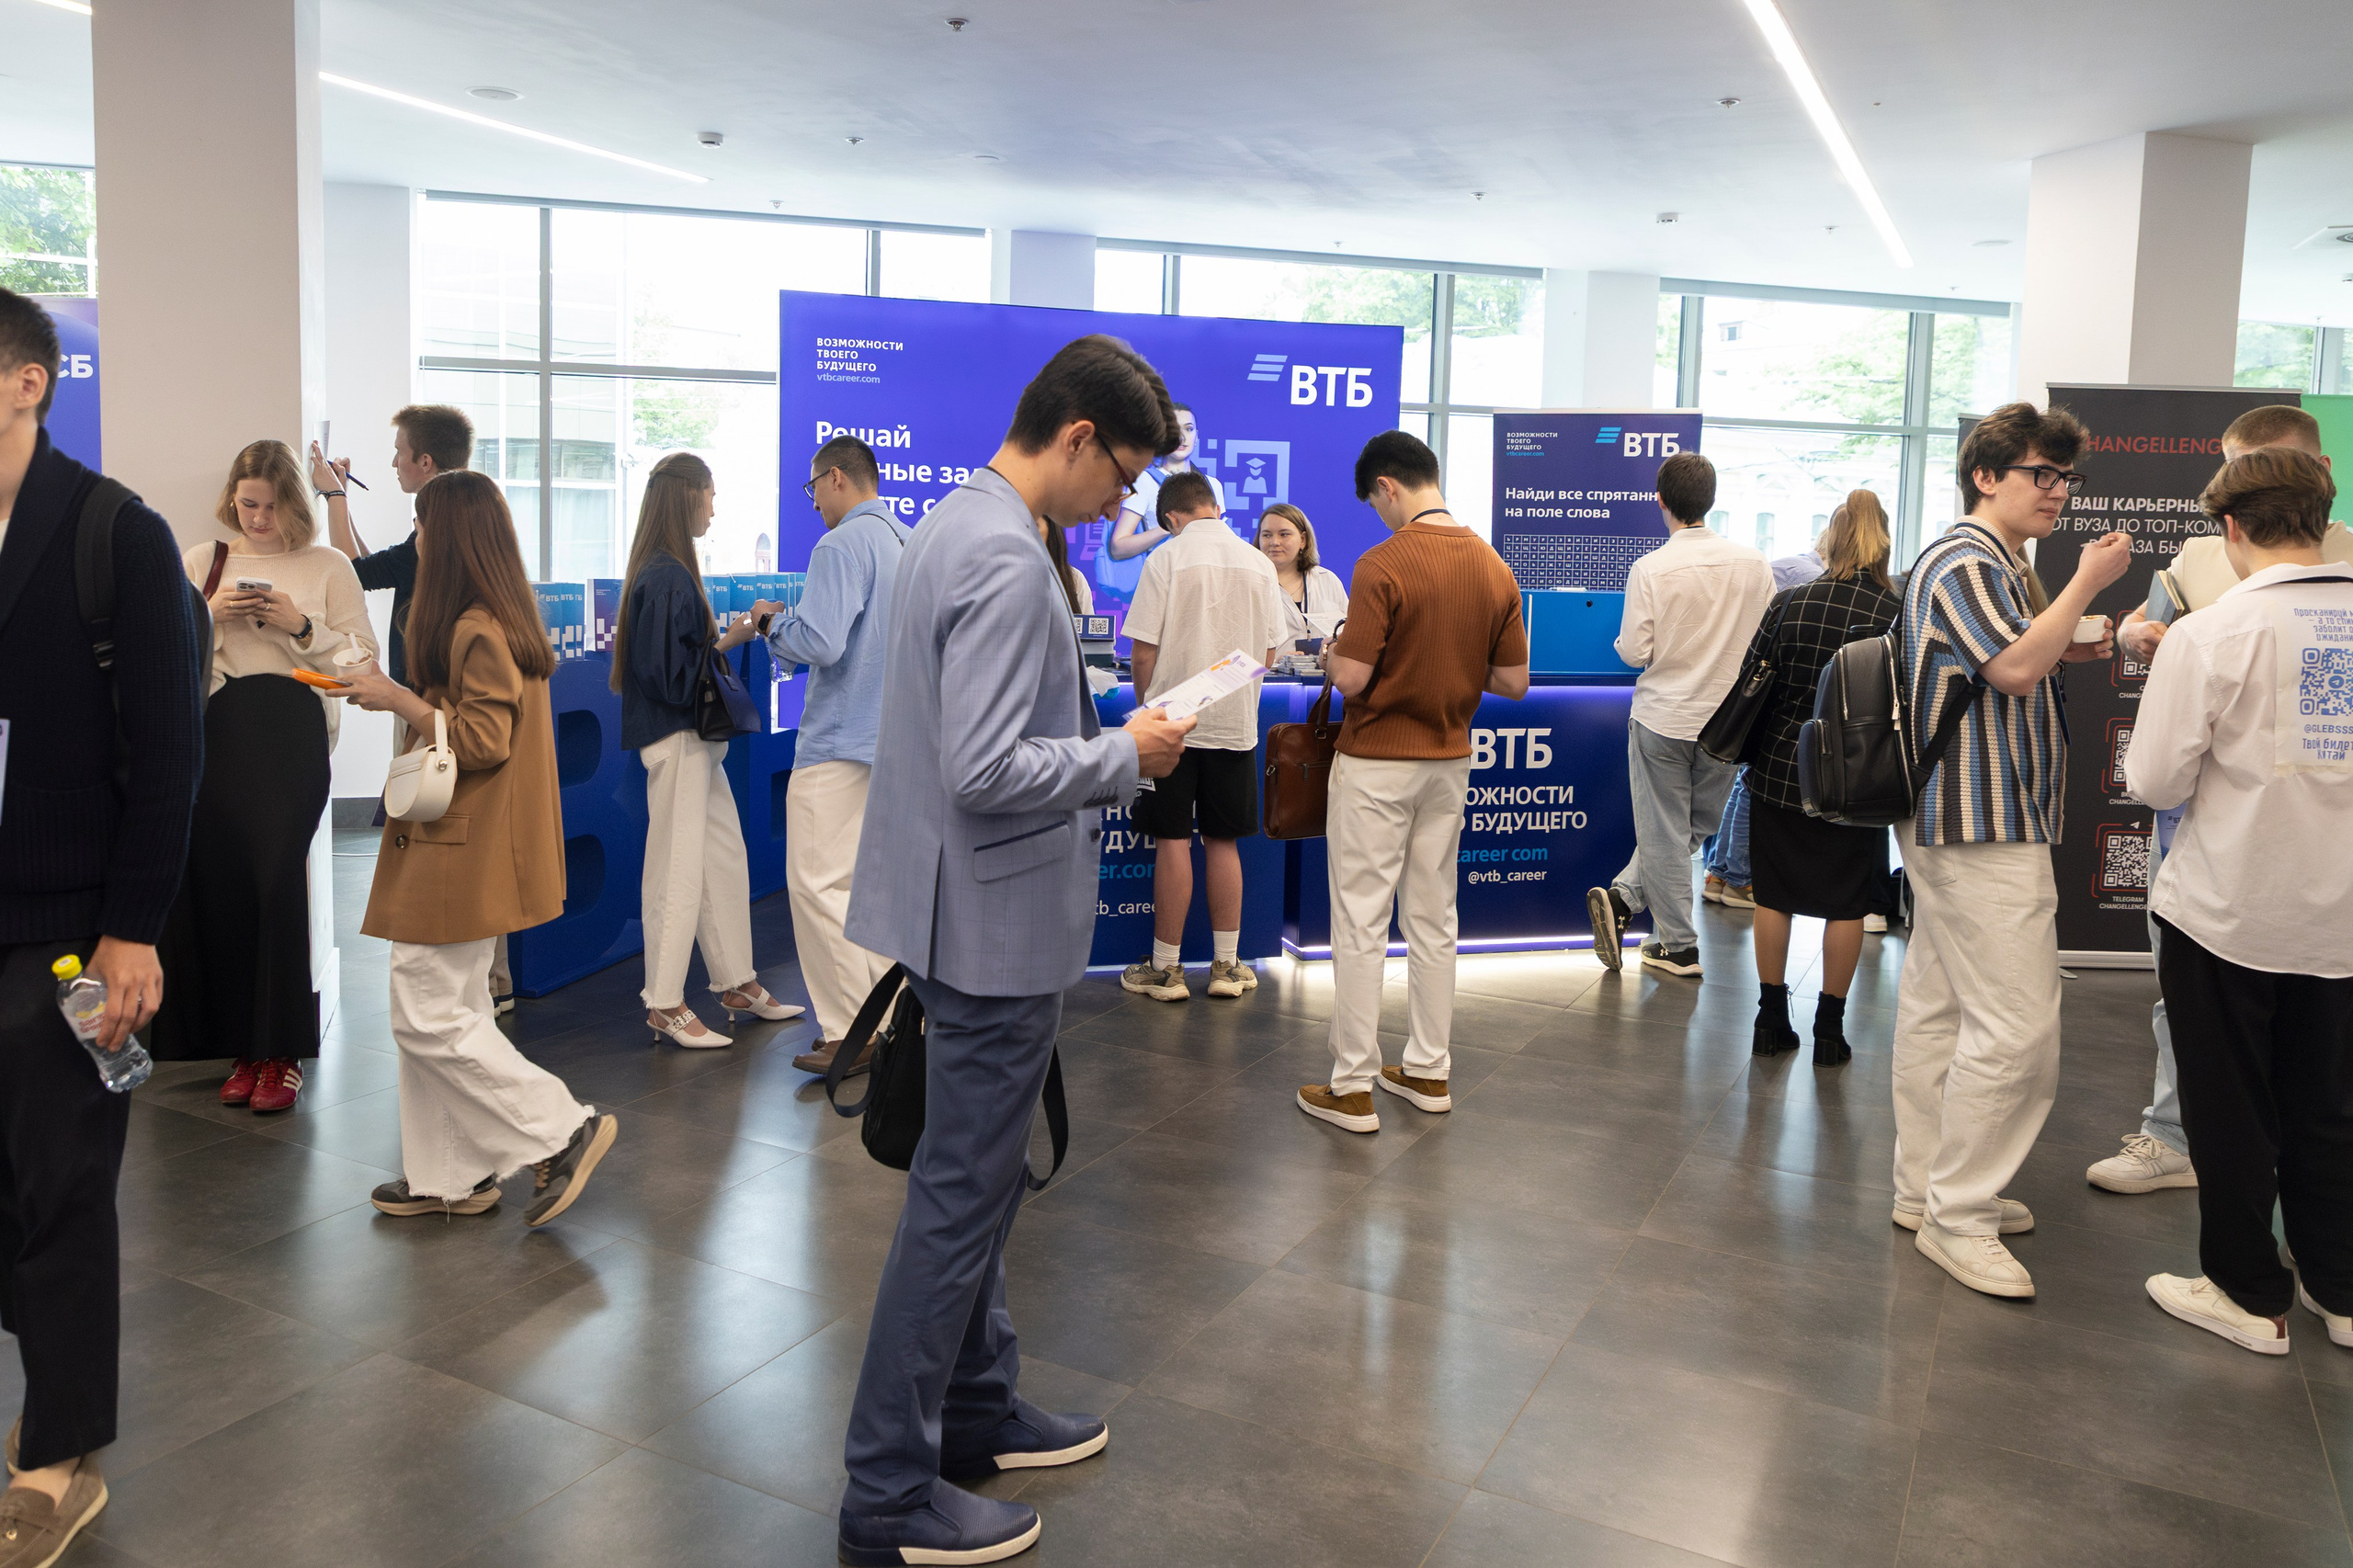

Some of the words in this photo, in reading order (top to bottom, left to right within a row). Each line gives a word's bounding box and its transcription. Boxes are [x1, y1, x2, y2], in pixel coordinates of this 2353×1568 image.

[816, 337, 904, 351] ВОЗМОЖНОСТИ
[816, 349, 858, 359] ТВОЕГО
[816, 360, 877, 372] БУДУЩЕГО
[817, 373, 881, 383] vtbcareer.com
[1290, 365, 1373, 407] ВТБ
[816, 421, 911, 449] Решай
[1623, 432, 1680, 457] ВТБ
[2086, 436, 2222, 455] HANGELLENG
[877, 463, 932, 483] ные
[939, 466, 976, 484] за
[1506, 487, 1554, 501] Найди
[1558, 491, 1583, 500] все
[1586, 491, 1658, 503] спрятанн
[879, 495, 915, 515] те
[2071, 496, 2109, 511] ВАШ
[2113, 497, 2204, 513] КАРЬЕРНЫ
[1505, 507, 1523, 517] на
[1527, 507, 1563, 517] поле
[1567, 508, 1610, 518] слова
[2052, 517, 2070, 531] ОТ
[2074, 517, 2110, 532] ВУЗА
[2115, 518, 2141, 533] ДО
[2144, 518, 2220, 534] ТОП-КОМ
[2159, 540, 2182, 554] БЫ
[2293, 608, 2347, 619] Просканируй
[2325, 617, 2335, 625] то
[2313, 624, 2347, 633] заболит
[2316, 633, 2353, 642] ожидани
[2304, 723, 2353, 734] @GLEBSSS
[1471, 728, 1552, 769] ВТБ
[2302, 737, 2321, 749] Твой
[1465, 786, 1574, 805] ОЖНОСТИ
[1472, 811, 1587, 835] БУДУЩЕГО
[1468, 869, 1547, 884] @vtb_career
